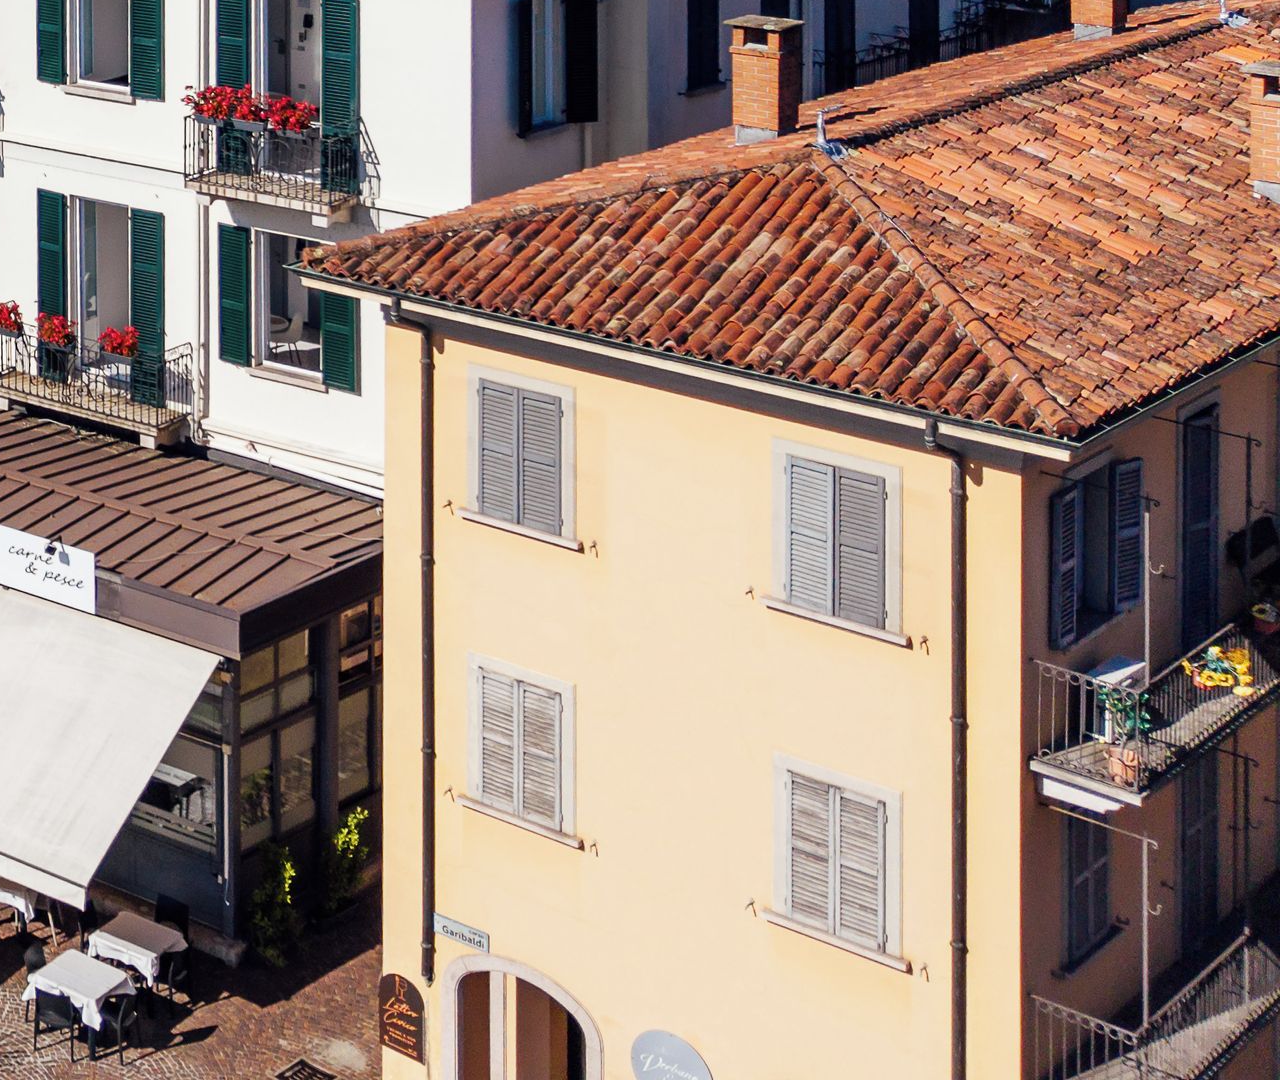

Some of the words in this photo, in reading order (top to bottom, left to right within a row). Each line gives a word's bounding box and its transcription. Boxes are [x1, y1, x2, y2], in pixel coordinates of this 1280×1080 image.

[8, 545, 53, 565] carne
[25, 561, 38, 575] &
[43, 571, 84, 589] pesce
[442, 924, 485, 949] Garibaldi
